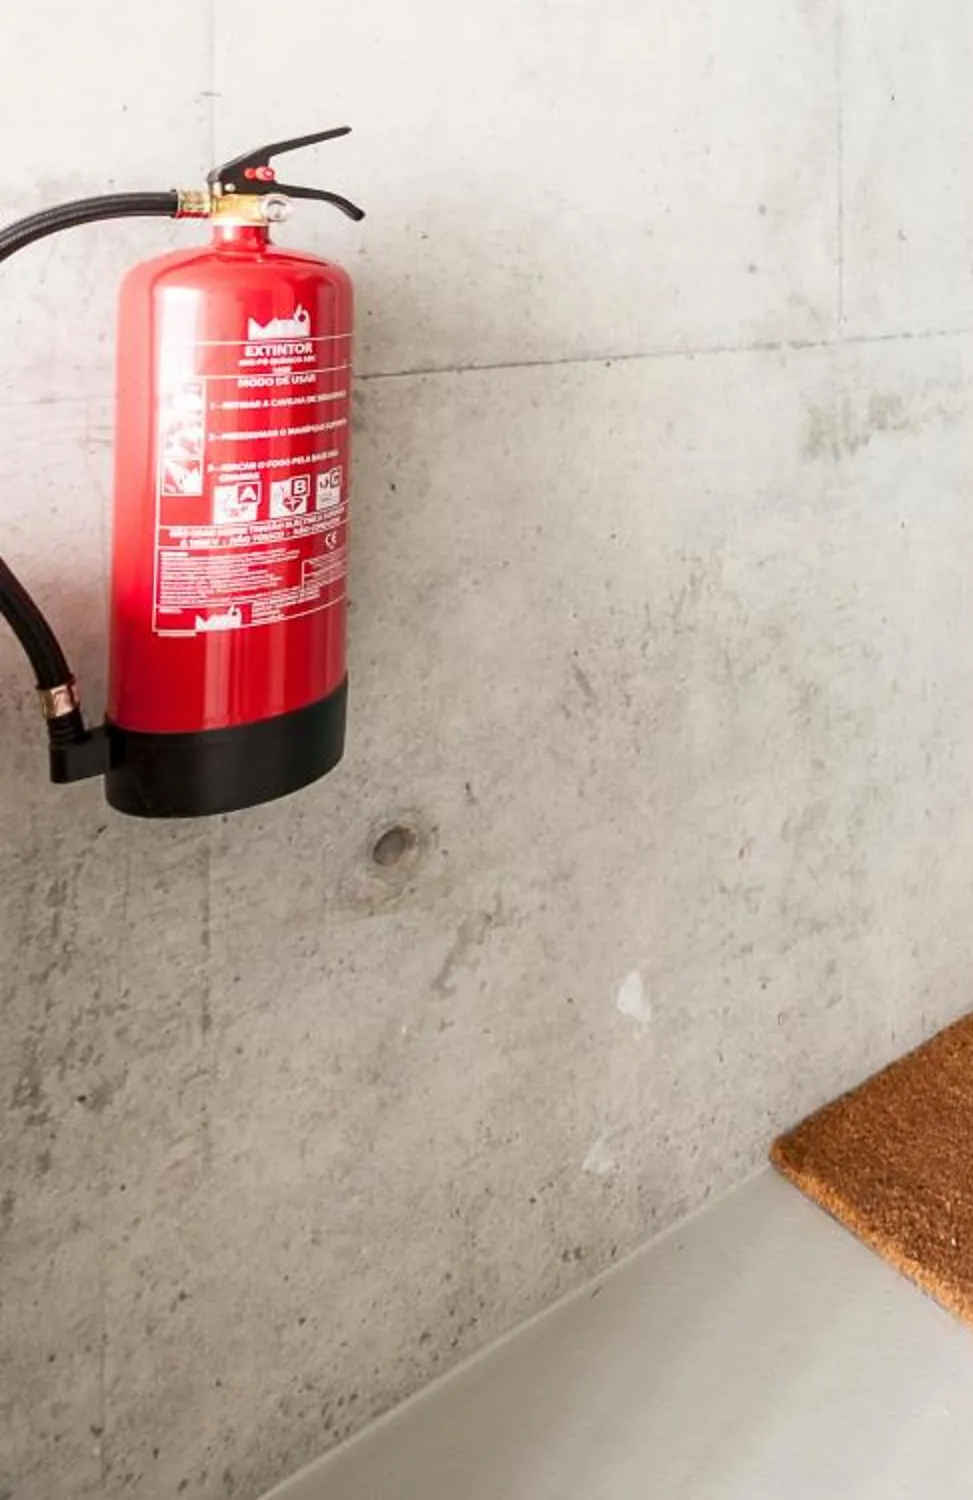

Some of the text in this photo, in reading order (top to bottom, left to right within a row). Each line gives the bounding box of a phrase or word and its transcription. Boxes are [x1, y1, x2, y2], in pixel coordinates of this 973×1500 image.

[245, 342, 313, 357] EXTINTOR
[237, 377, 275, 388] MODO
[240, 484, 258, 501] A
[293, 479, 307, 495] B
